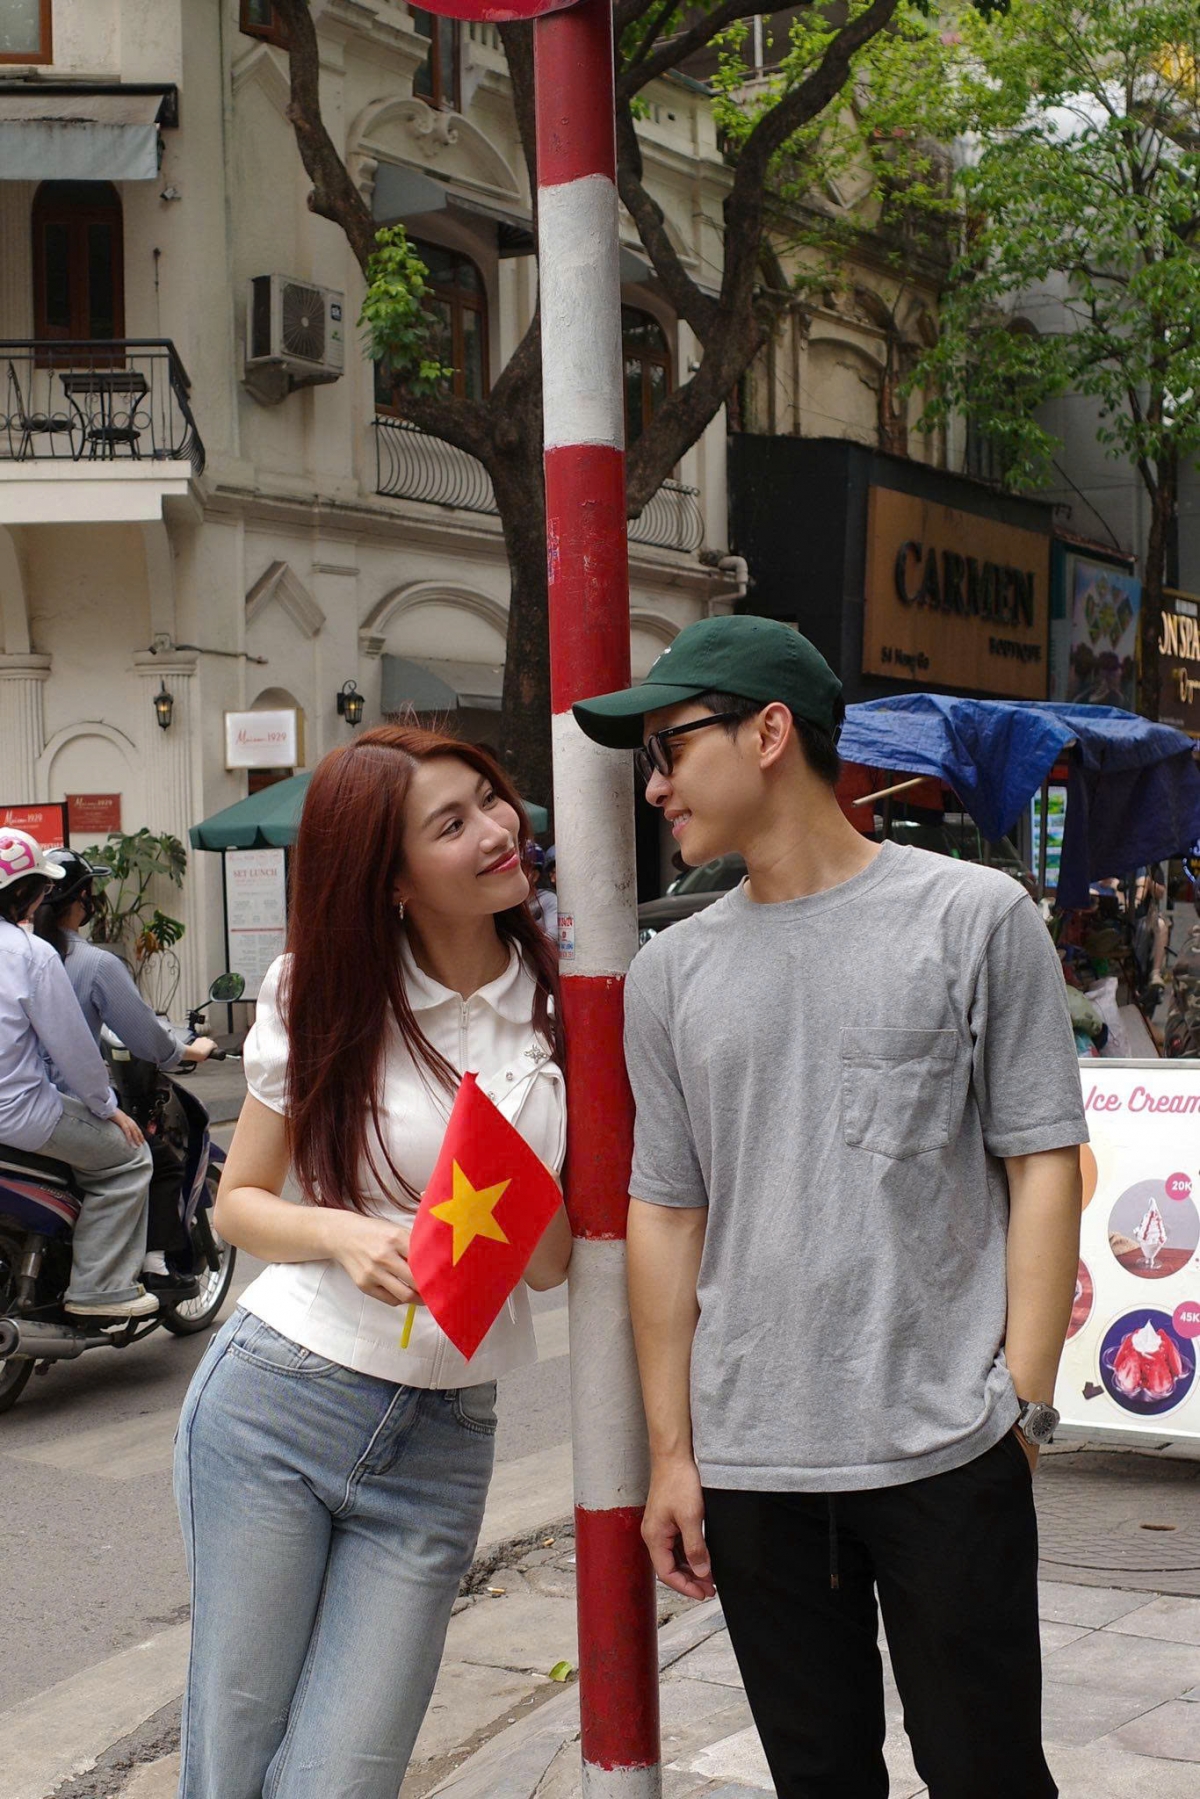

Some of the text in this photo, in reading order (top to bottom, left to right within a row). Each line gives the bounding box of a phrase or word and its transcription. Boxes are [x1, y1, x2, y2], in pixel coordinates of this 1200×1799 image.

[894, 541, 1036, 628] CARMEN
[1084, 1085, 1122, 1112] Ice
[1172, 1180, 1193, 1191] 20K
[1180, 1311, 1200, 1323] 45K
